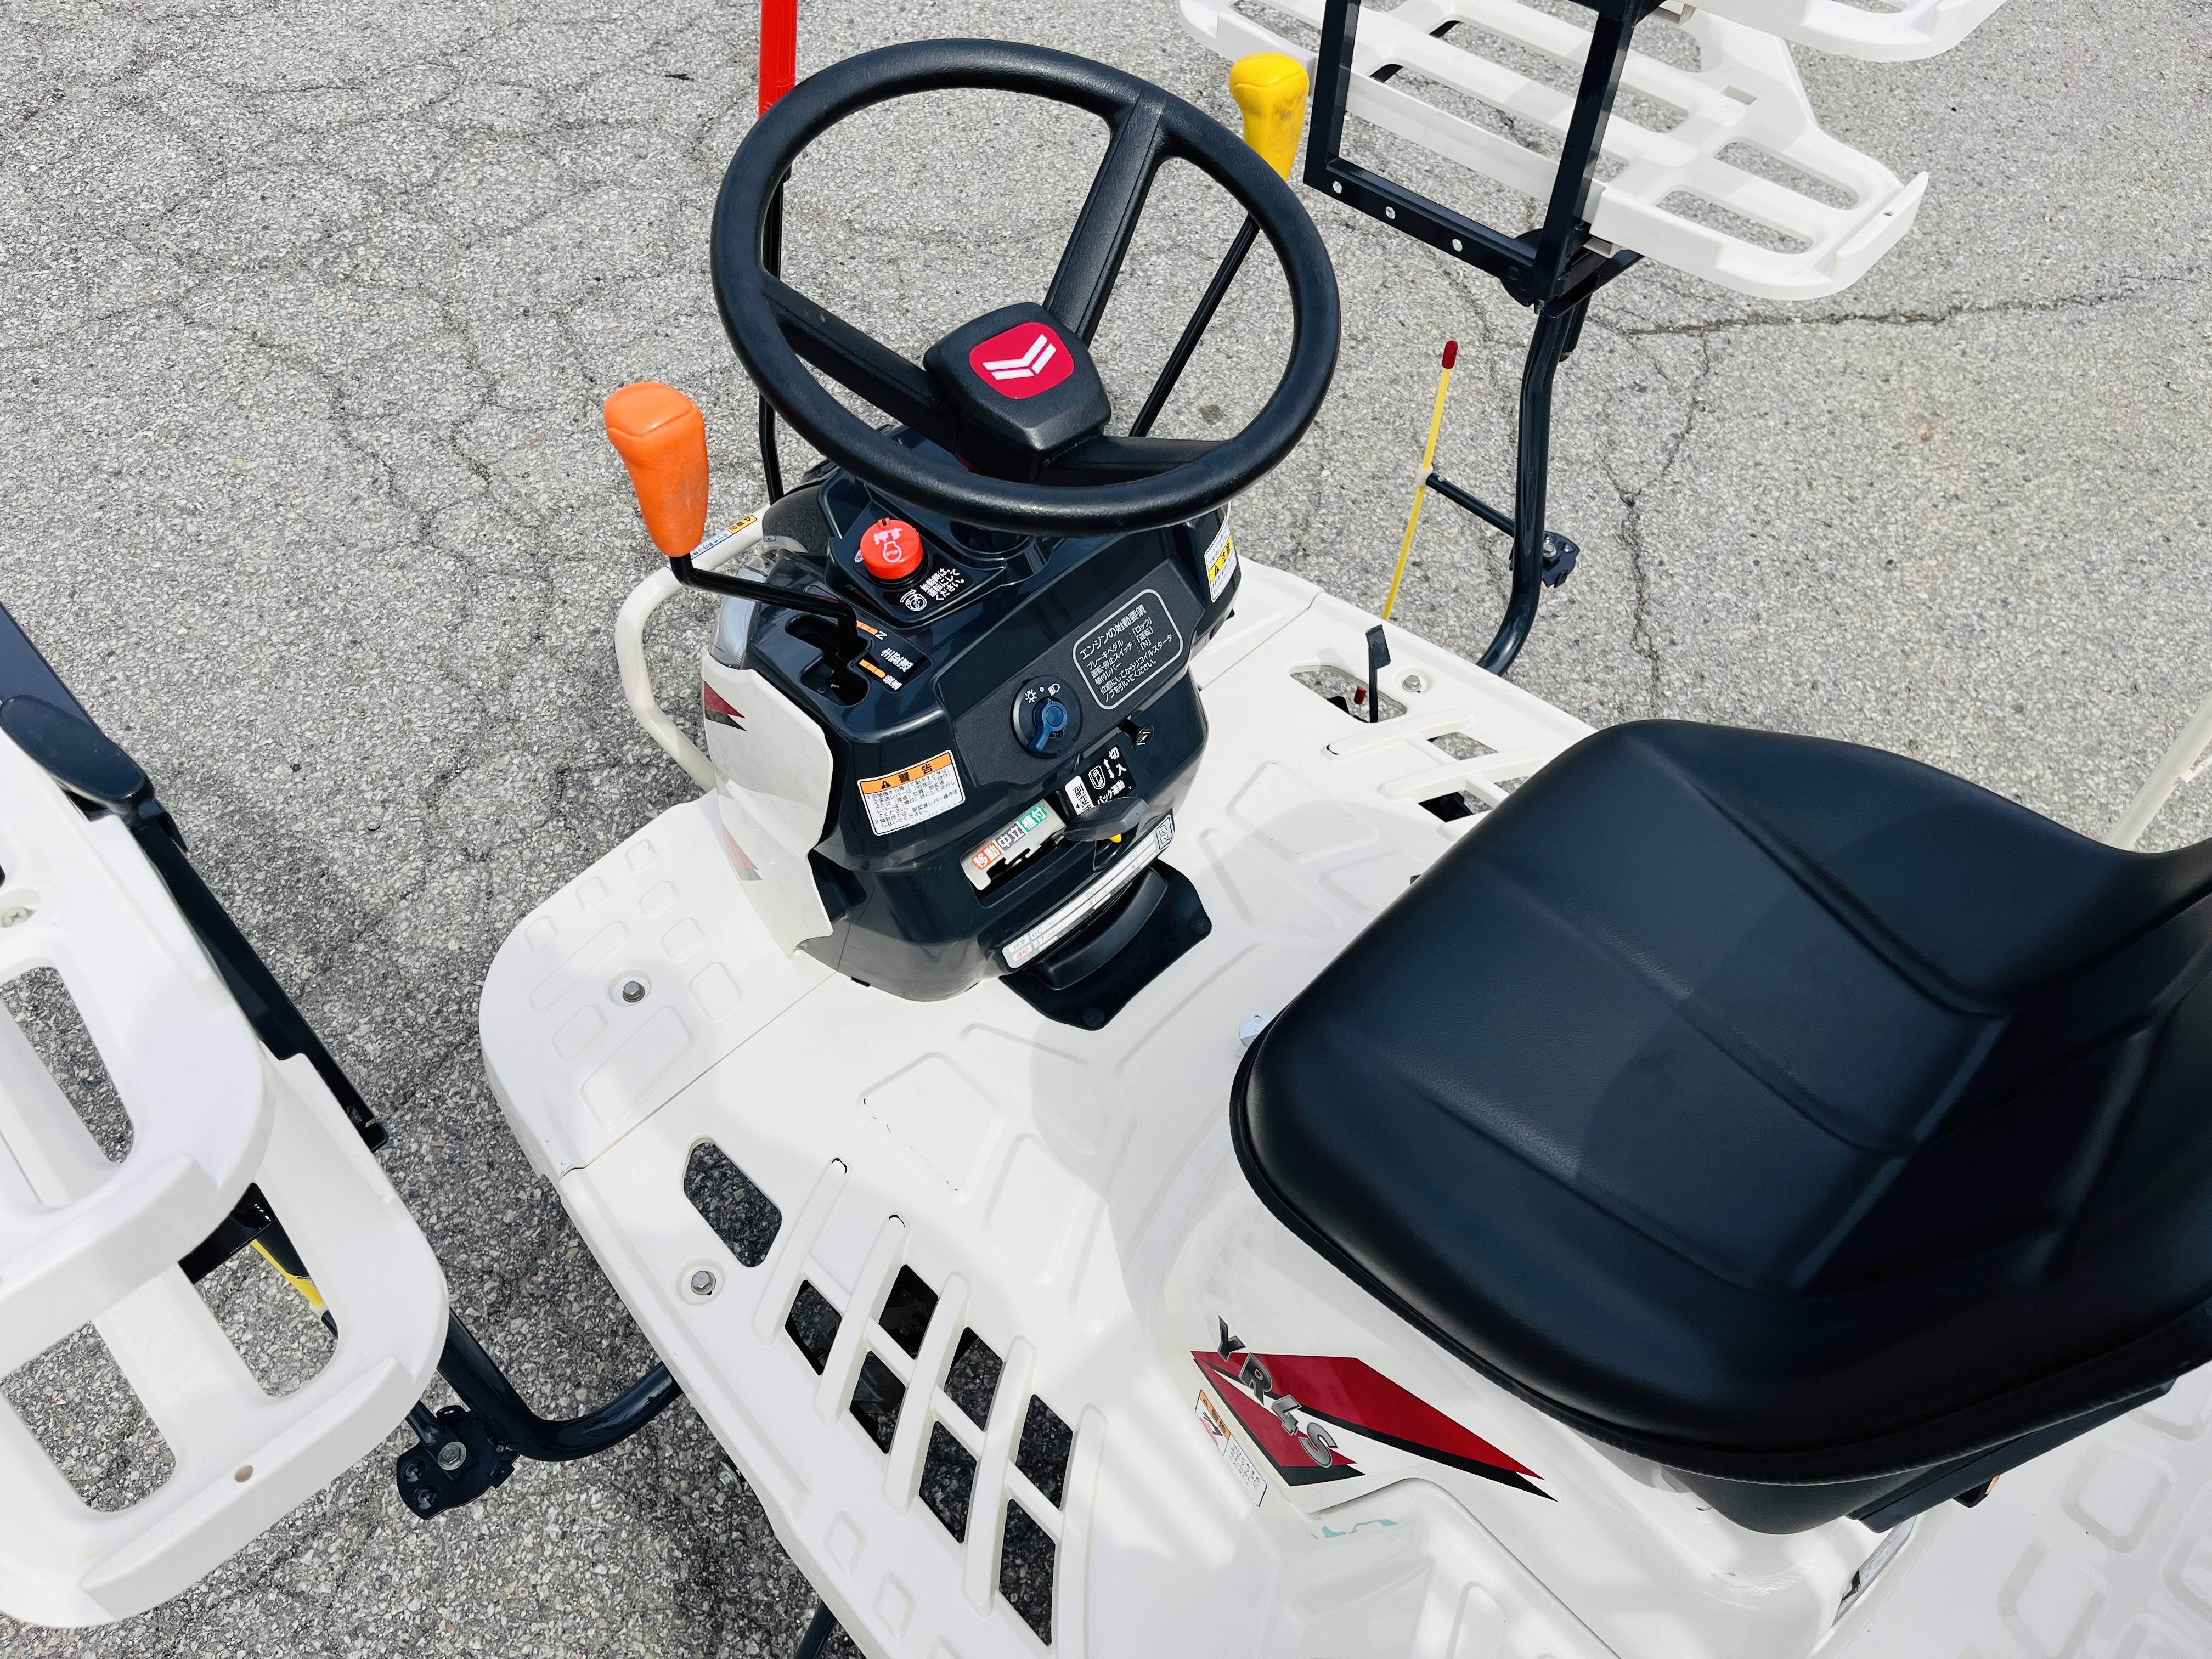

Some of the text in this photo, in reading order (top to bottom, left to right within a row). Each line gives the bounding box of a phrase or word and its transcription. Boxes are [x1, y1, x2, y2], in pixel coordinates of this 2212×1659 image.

[873, 527, 902, 545] 押す
[885, 549, 899, 557] STOP
[935, 578, 964, 601] ください。
[875, 630, 887, 640] N
[1080, 604, 1147, 660] エンジンの始動要領
[1087, 639, 1124, 670] ブレーキペダル
[1108, 746, 1120, 760] 切
[1116, 763, 1127, 776] 入
[973, 806, 1046, 868] 移動 中立 植付
